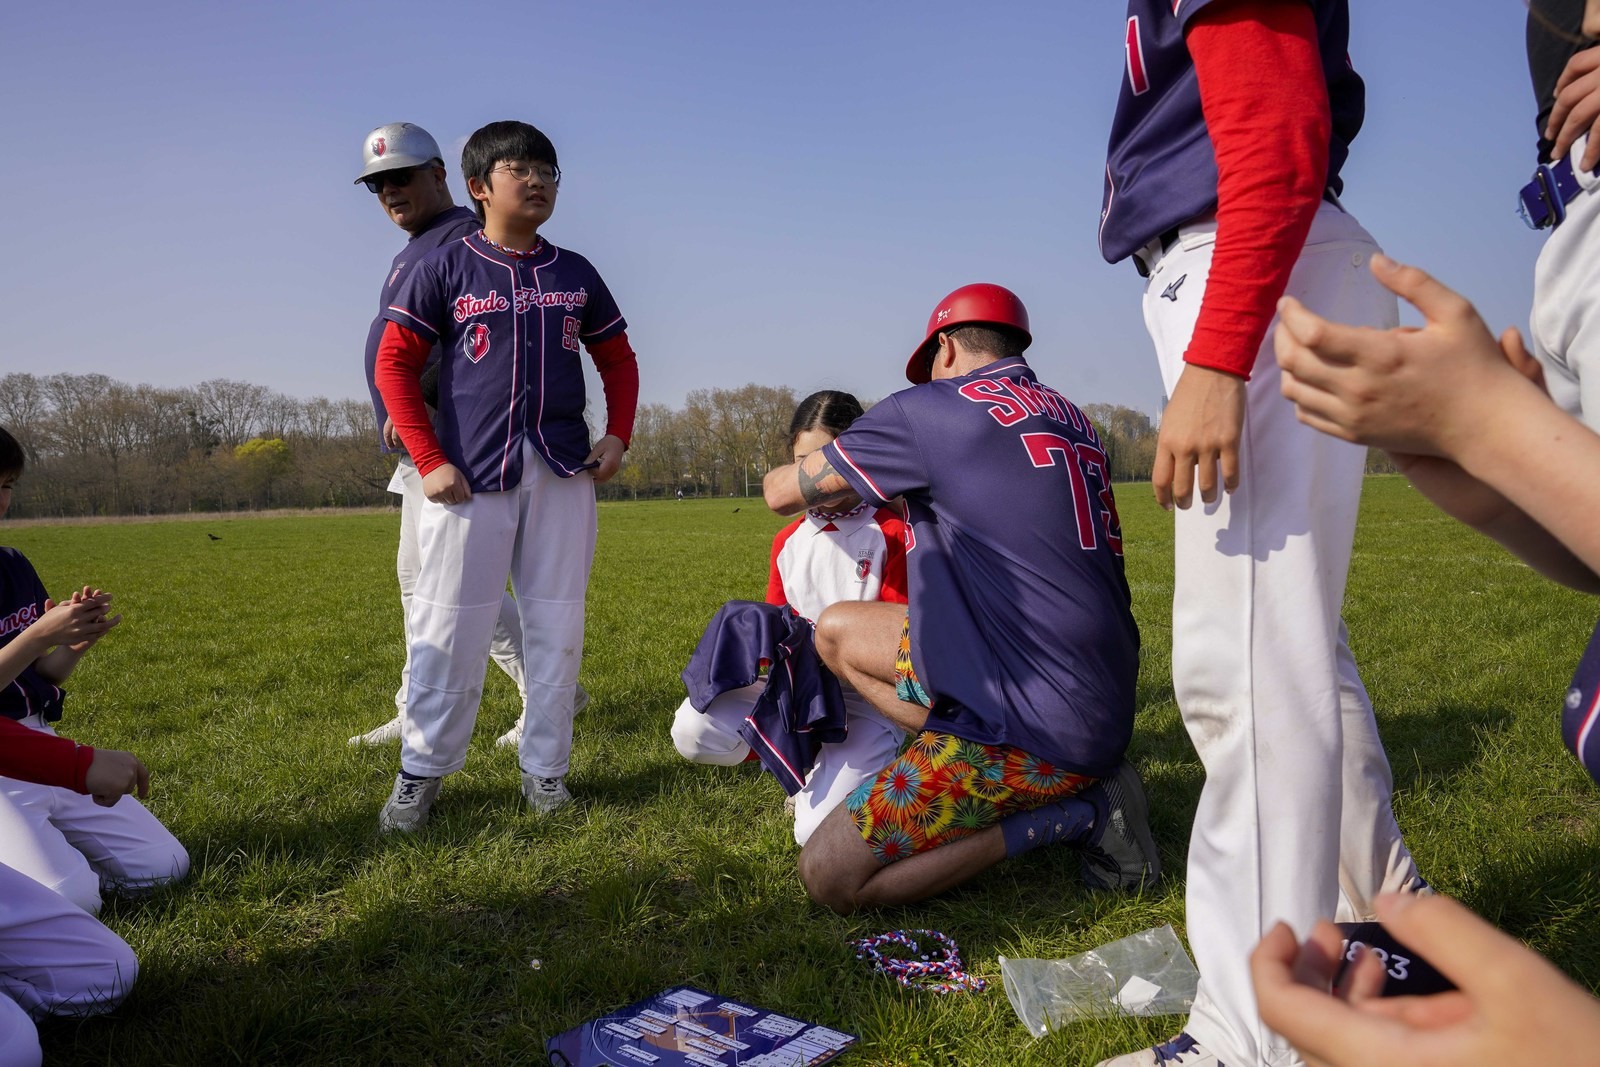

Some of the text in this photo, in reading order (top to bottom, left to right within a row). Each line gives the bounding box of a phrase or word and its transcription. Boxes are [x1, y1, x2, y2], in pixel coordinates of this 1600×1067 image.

[1125, 15, 1150, 96] 1
[453, 287, 588, 323] Stade Français
[468, 333, 484, 347] SF
[1020, 432, 1124, 556] 73
